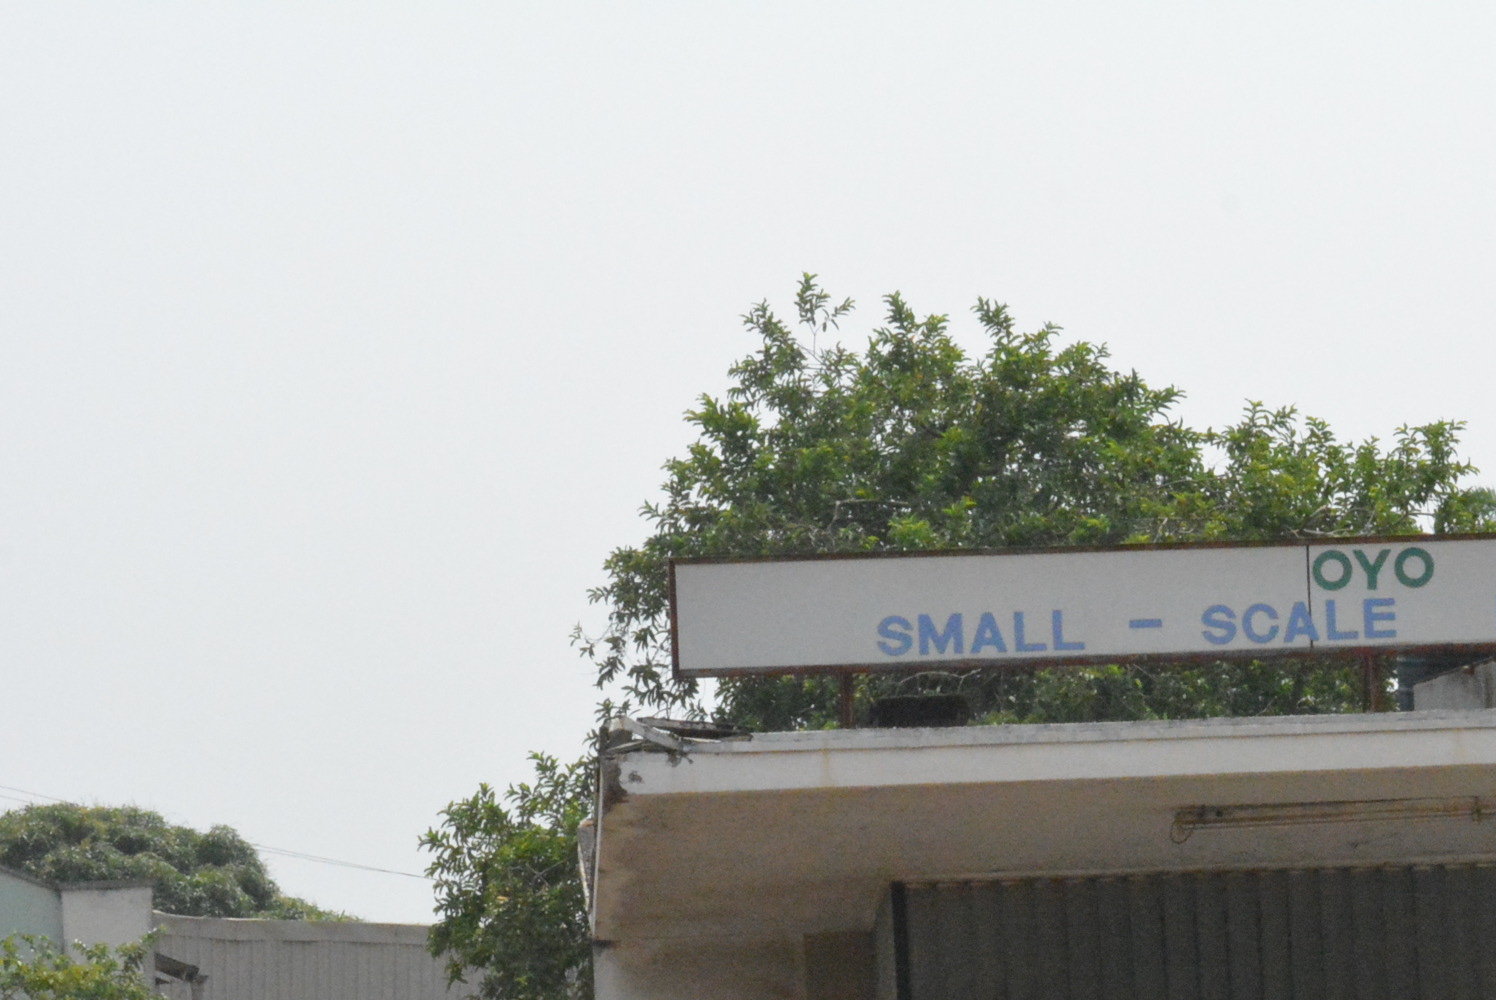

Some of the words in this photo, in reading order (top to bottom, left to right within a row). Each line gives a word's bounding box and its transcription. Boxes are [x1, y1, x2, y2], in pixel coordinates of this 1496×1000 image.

[1312, 547, 1435, 591] OYO
[877, 610, 1085, 657] SMALL
[1201, 597, 1398, 646] SCALE
